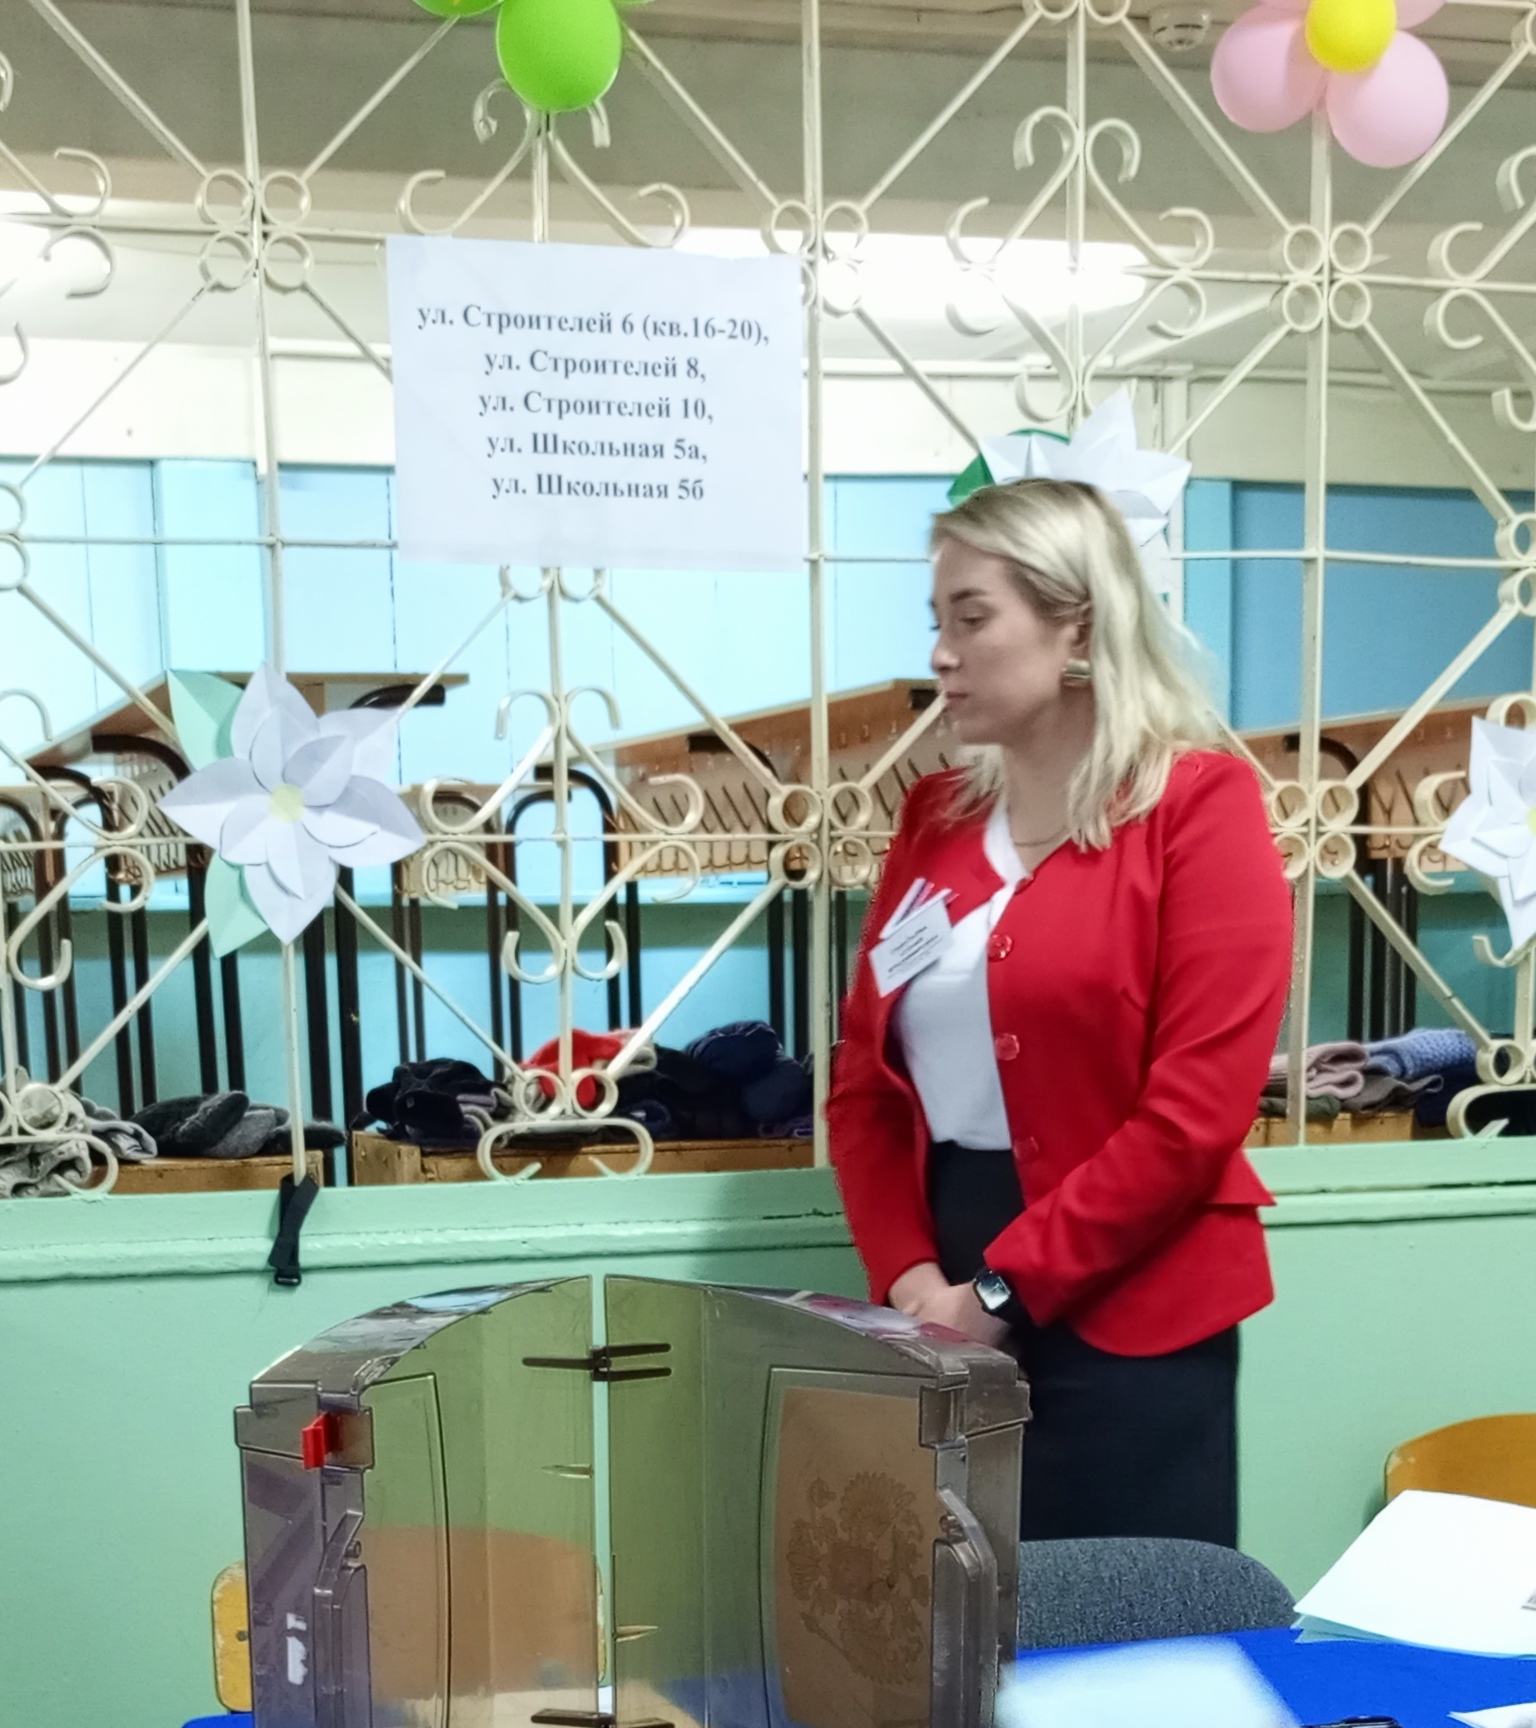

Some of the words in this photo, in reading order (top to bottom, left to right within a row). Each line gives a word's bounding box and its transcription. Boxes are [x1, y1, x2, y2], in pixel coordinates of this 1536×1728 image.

[417, 307, 454, 331] ул.
[463, 304, 612, 336] Строителей
[621, 313, 635, 335] 6
[642, 314, 770, 347] (кв.16-20),
[484, 353, 520, 376] ул.
[529, 349, 677, 379] Строителей
[686, 357, 706, 383] 8,
[478, 394, 514, 417] ул.
[523, 390, 671, 420] Строителей
[681, 398, 713, 424] 10,
[487, 436, 522, 458] ул.
[531, 432, 665, 459] Школьная
[673, 438, 708, 464] 5а,
[491, 477, 527, 500] ул.
[536, 473, 669, 500] Школьная
[677, 478, 704, 501] 5б
